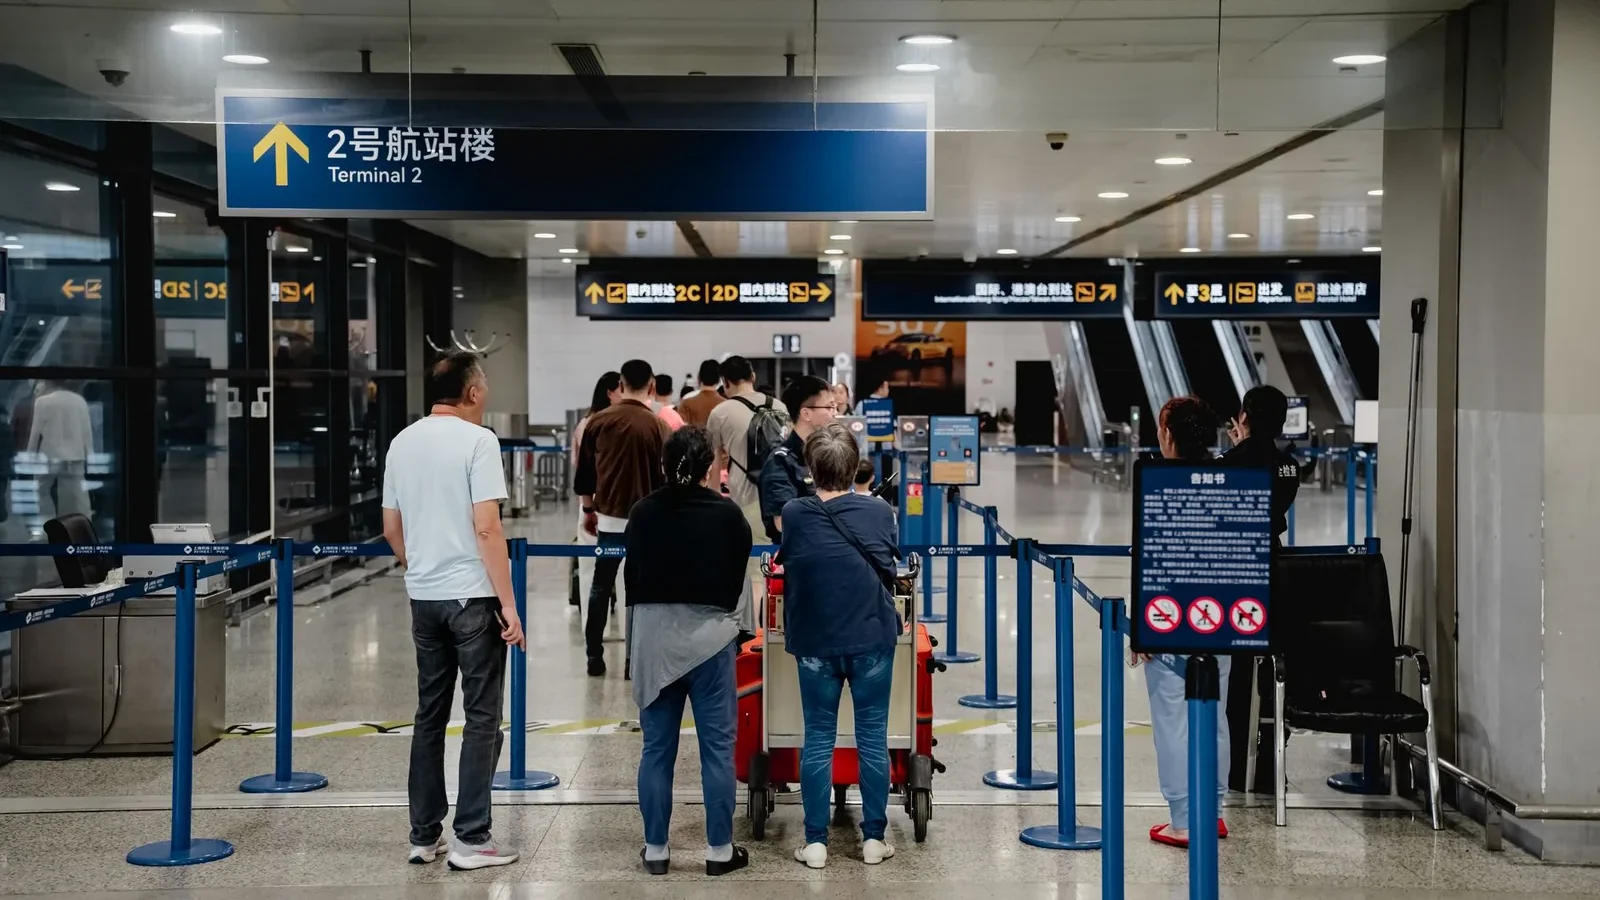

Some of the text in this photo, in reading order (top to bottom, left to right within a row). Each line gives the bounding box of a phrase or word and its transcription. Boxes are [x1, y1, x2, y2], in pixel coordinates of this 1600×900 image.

[327, 126, 496, 163] 2号航站楼
[328, 166, 423, 184] Terminal 2
[675, 284, 739, 302] 2C 2D
[1257, 282, 1283, 296] 出发
[1190, 473, 1226, 485] 告知书
